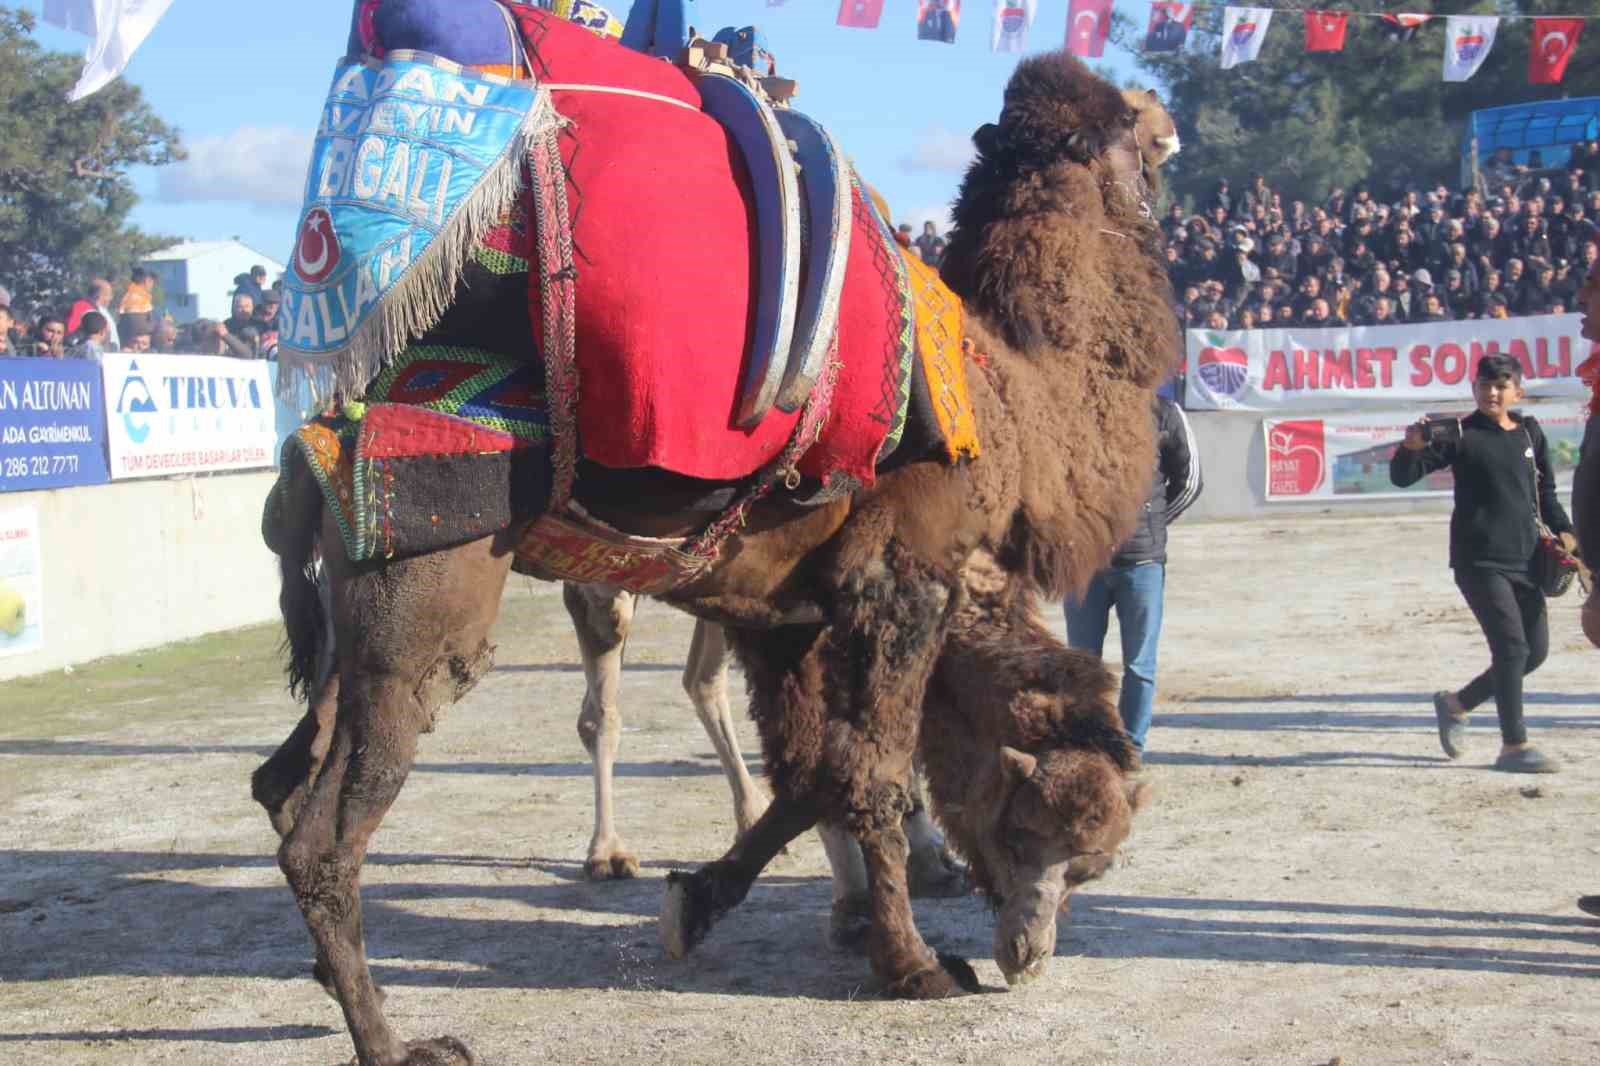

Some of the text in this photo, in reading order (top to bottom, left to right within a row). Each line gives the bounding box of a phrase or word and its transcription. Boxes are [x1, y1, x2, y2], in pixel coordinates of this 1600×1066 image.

[1263, 347, 1398, 391] AHMET
[22, 380, 91, 411] ALTUNAN
[162, 376, 262, 409] TRUVA
[3, 425, 26, 444] ADA
[5, 456, 29, 477] 286
[31, 455, 49, 475] 212
